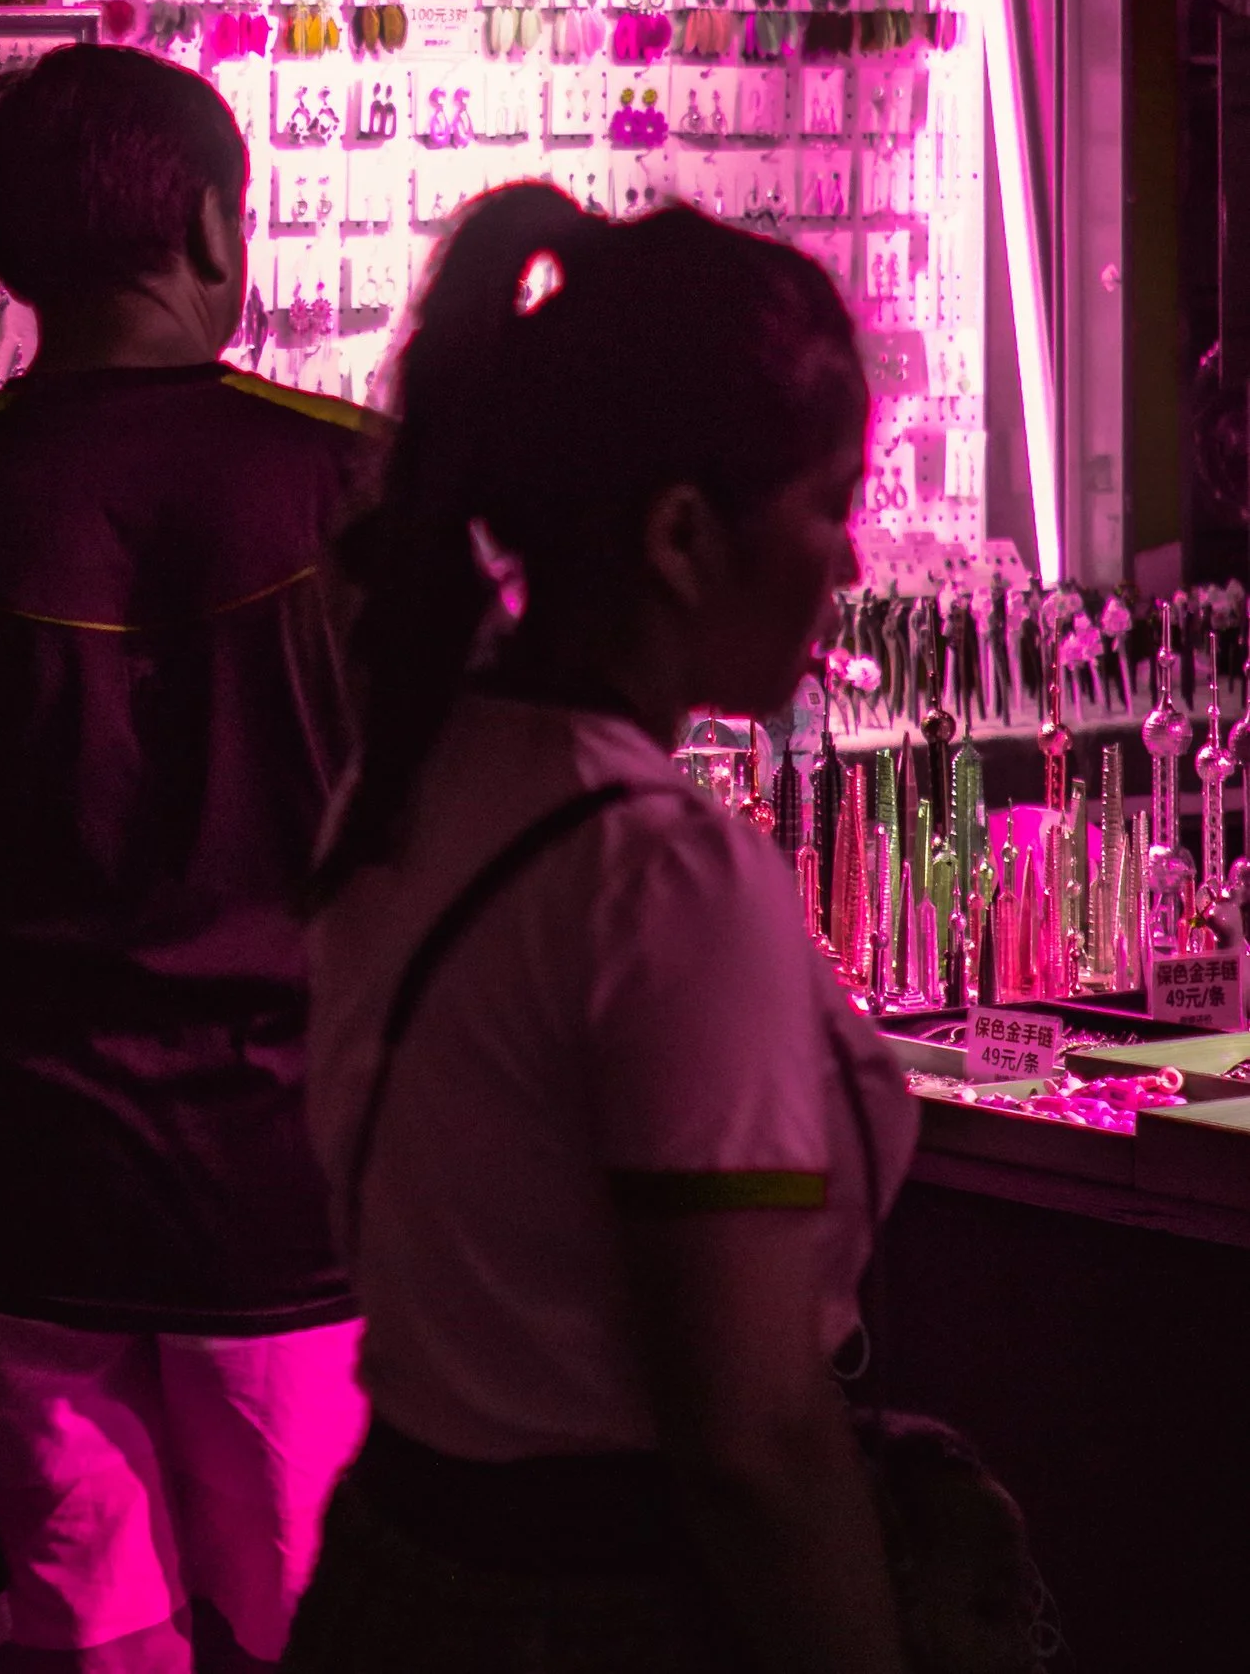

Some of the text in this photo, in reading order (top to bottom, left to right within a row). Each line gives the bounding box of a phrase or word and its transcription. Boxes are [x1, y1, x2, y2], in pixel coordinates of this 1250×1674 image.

[1165, 985, 1226, 1008] 49元/条
[975, 1015, 1054, 1048] 保色金手链
[981, 1046, 1039, 1074] 49元/条
